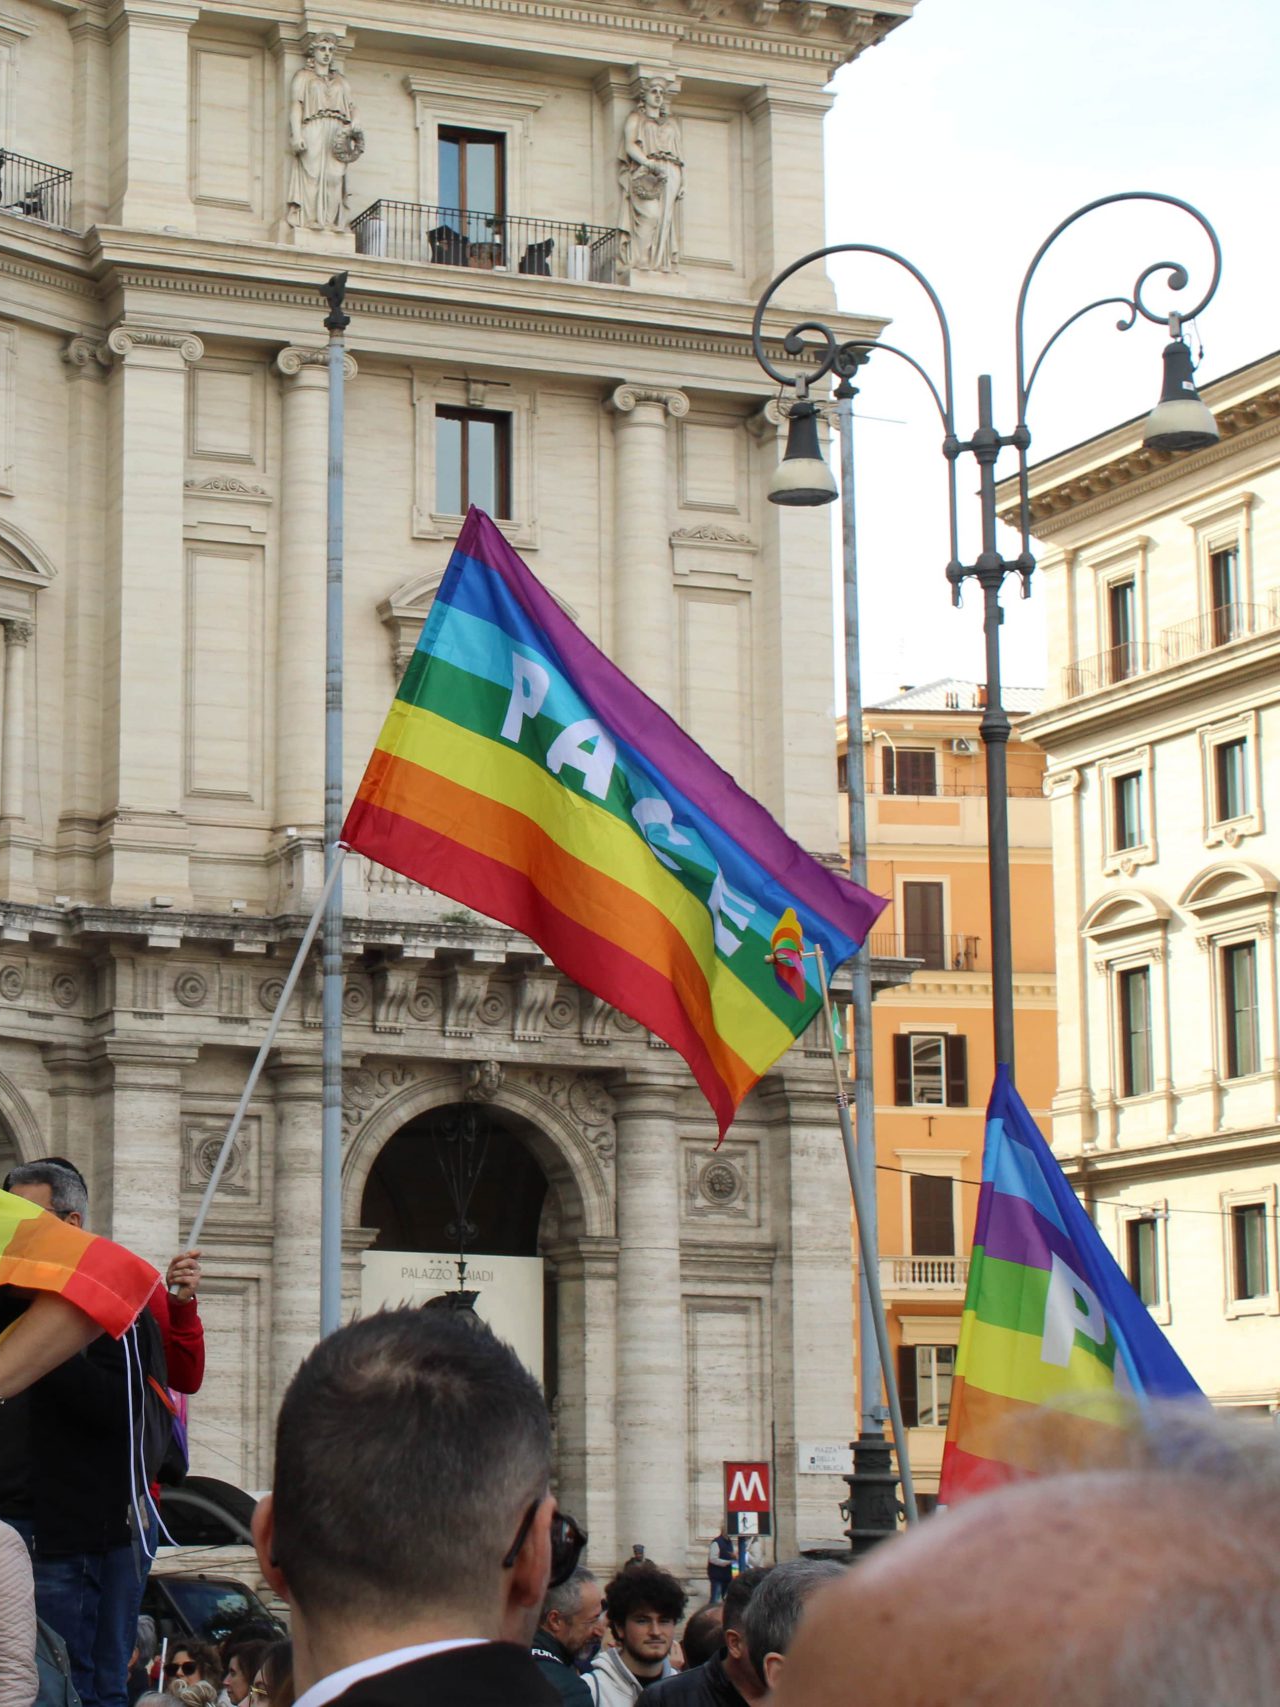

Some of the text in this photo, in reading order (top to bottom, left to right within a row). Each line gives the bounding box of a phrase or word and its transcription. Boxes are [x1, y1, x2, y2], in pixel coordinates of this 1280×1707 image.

[500, 651, 756, 957] PACE
[401, 1267, 494, 1282] PALAZZO AIADI
[729, 1471, 767, 1502] M
